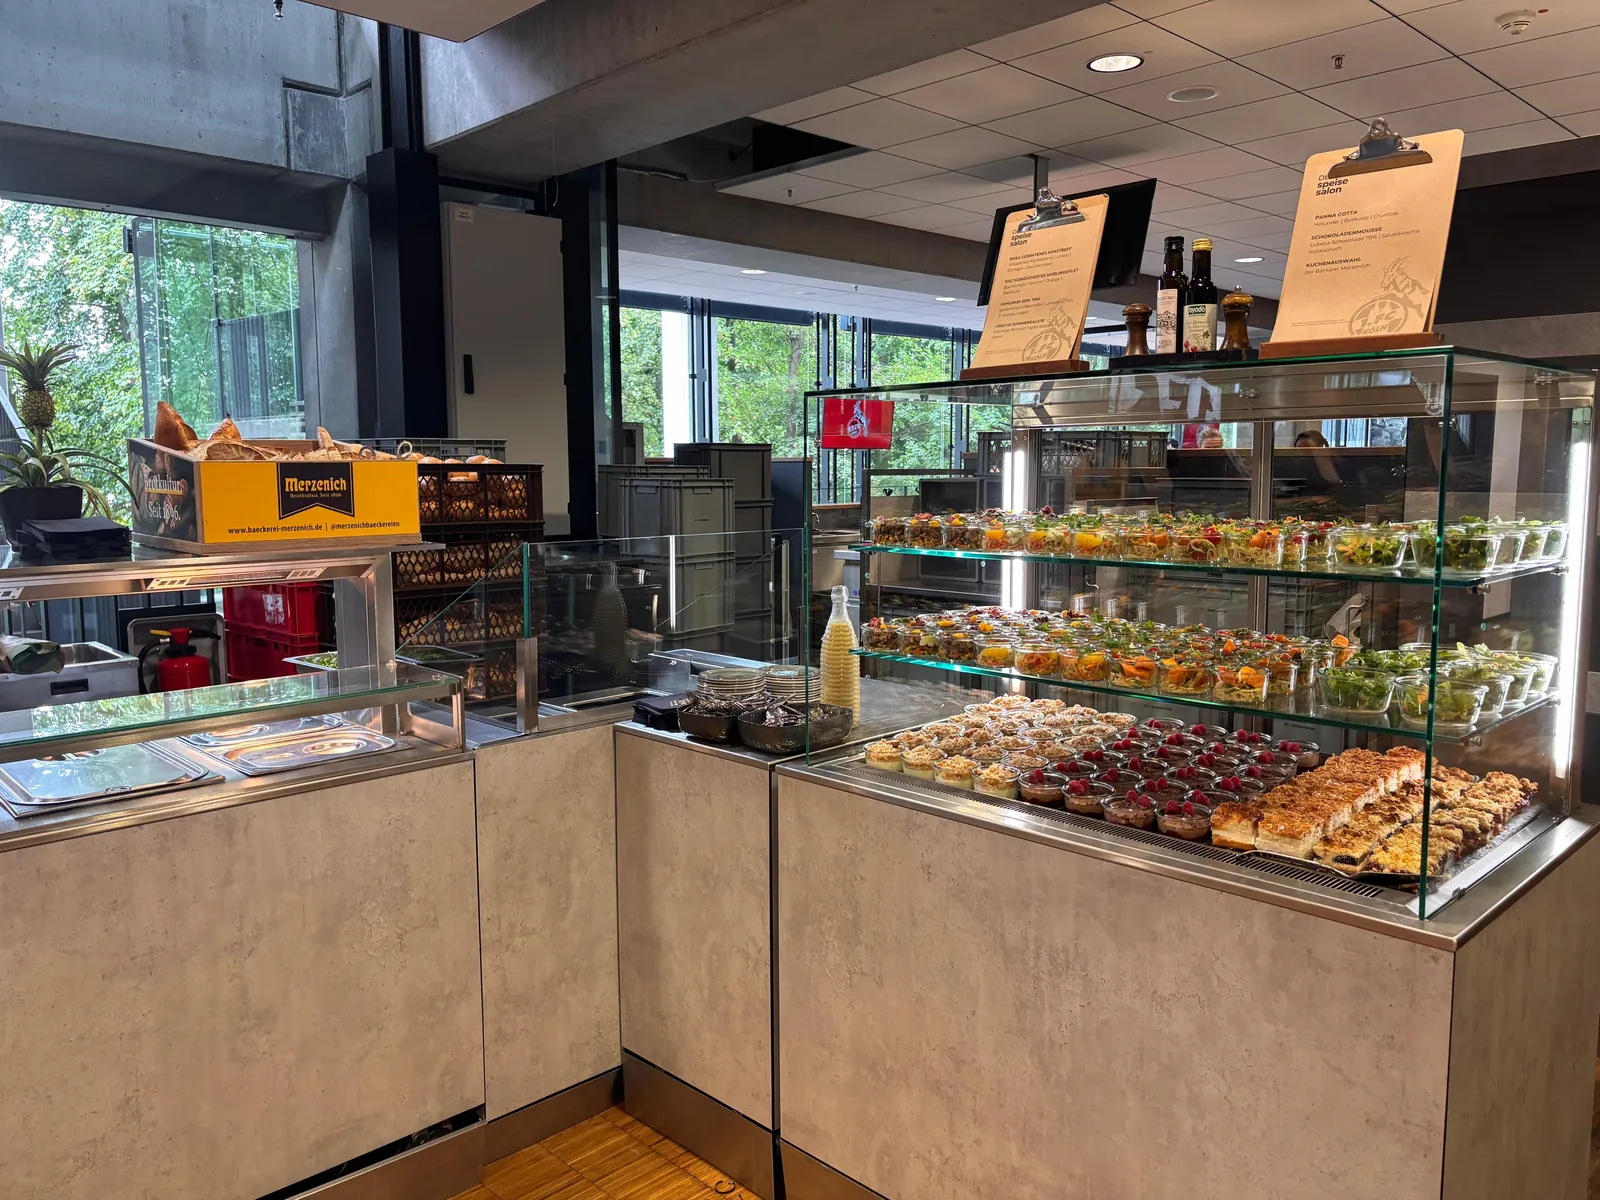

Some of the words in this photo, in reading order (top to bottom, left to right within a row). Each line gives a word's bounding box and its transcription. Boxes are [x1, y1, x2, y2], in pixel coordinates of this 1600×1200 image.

[1317, 178, 1348, 189] speise
[1316, 187, 1342, 196] salon
[1372, 211, 1399, 219] Crumble
[1011, 232, 1032, 241] speise
[1311, 226, 1382, 240] SCHOKOLADENMOUSSE
[1332, 236, 1364, 245] Schokolade
[1306, 256, 1362, 268] KUCHENAUSWAHL
[144, 474, 182, 492] Brotkultur.
[285, 477, 347, 492] Merzenich
[148, 500, 162, 518] Seit
[162, 504, 180, 523] 1896.
[228, 524, 322, 534] www.baeckerei-merzenich.de
[330, 521, 400, 531] @merzenichbaeckereien
